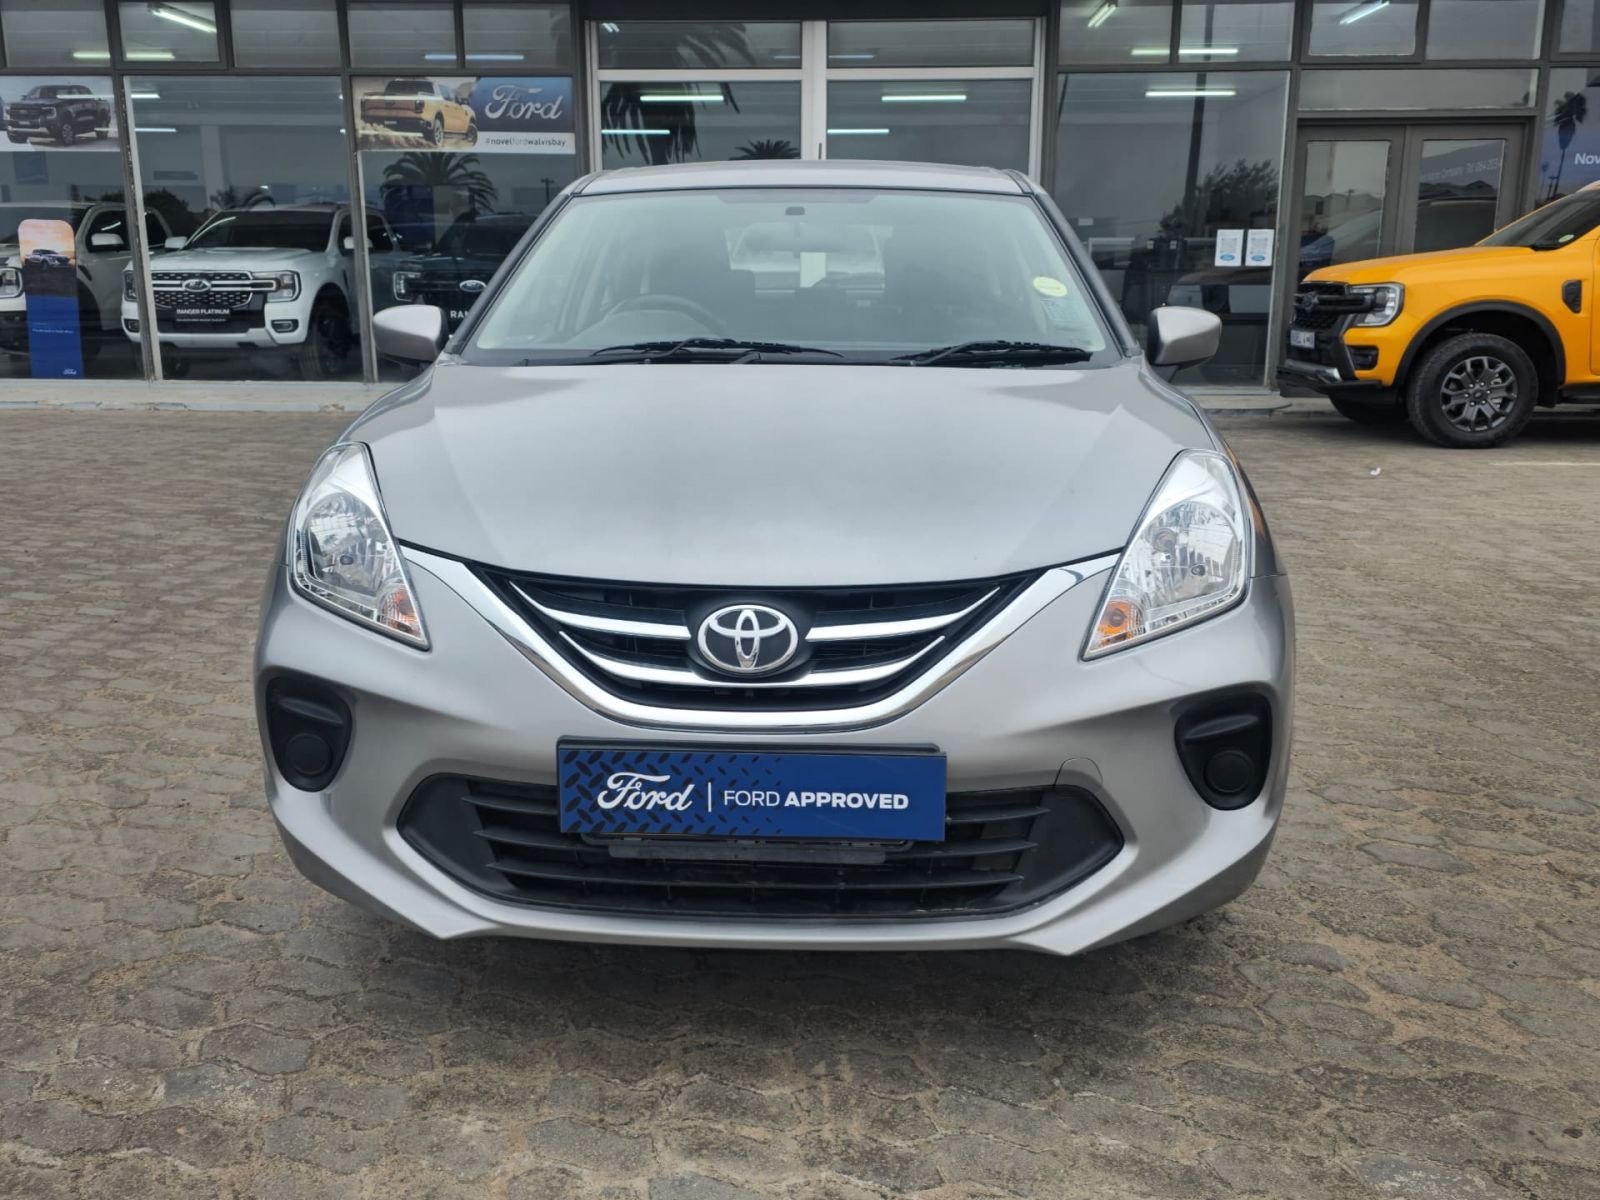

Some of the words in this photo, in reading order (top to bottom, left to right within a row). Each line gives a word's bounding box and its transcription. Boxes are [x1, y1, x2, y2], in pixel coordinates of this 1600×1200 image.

[485, 84, 564, 119] Ford
[597, 772, 695, 811] Ford
[724, 790, 780, 807] FORD
[784, 791, 910, 810] APPROVED
